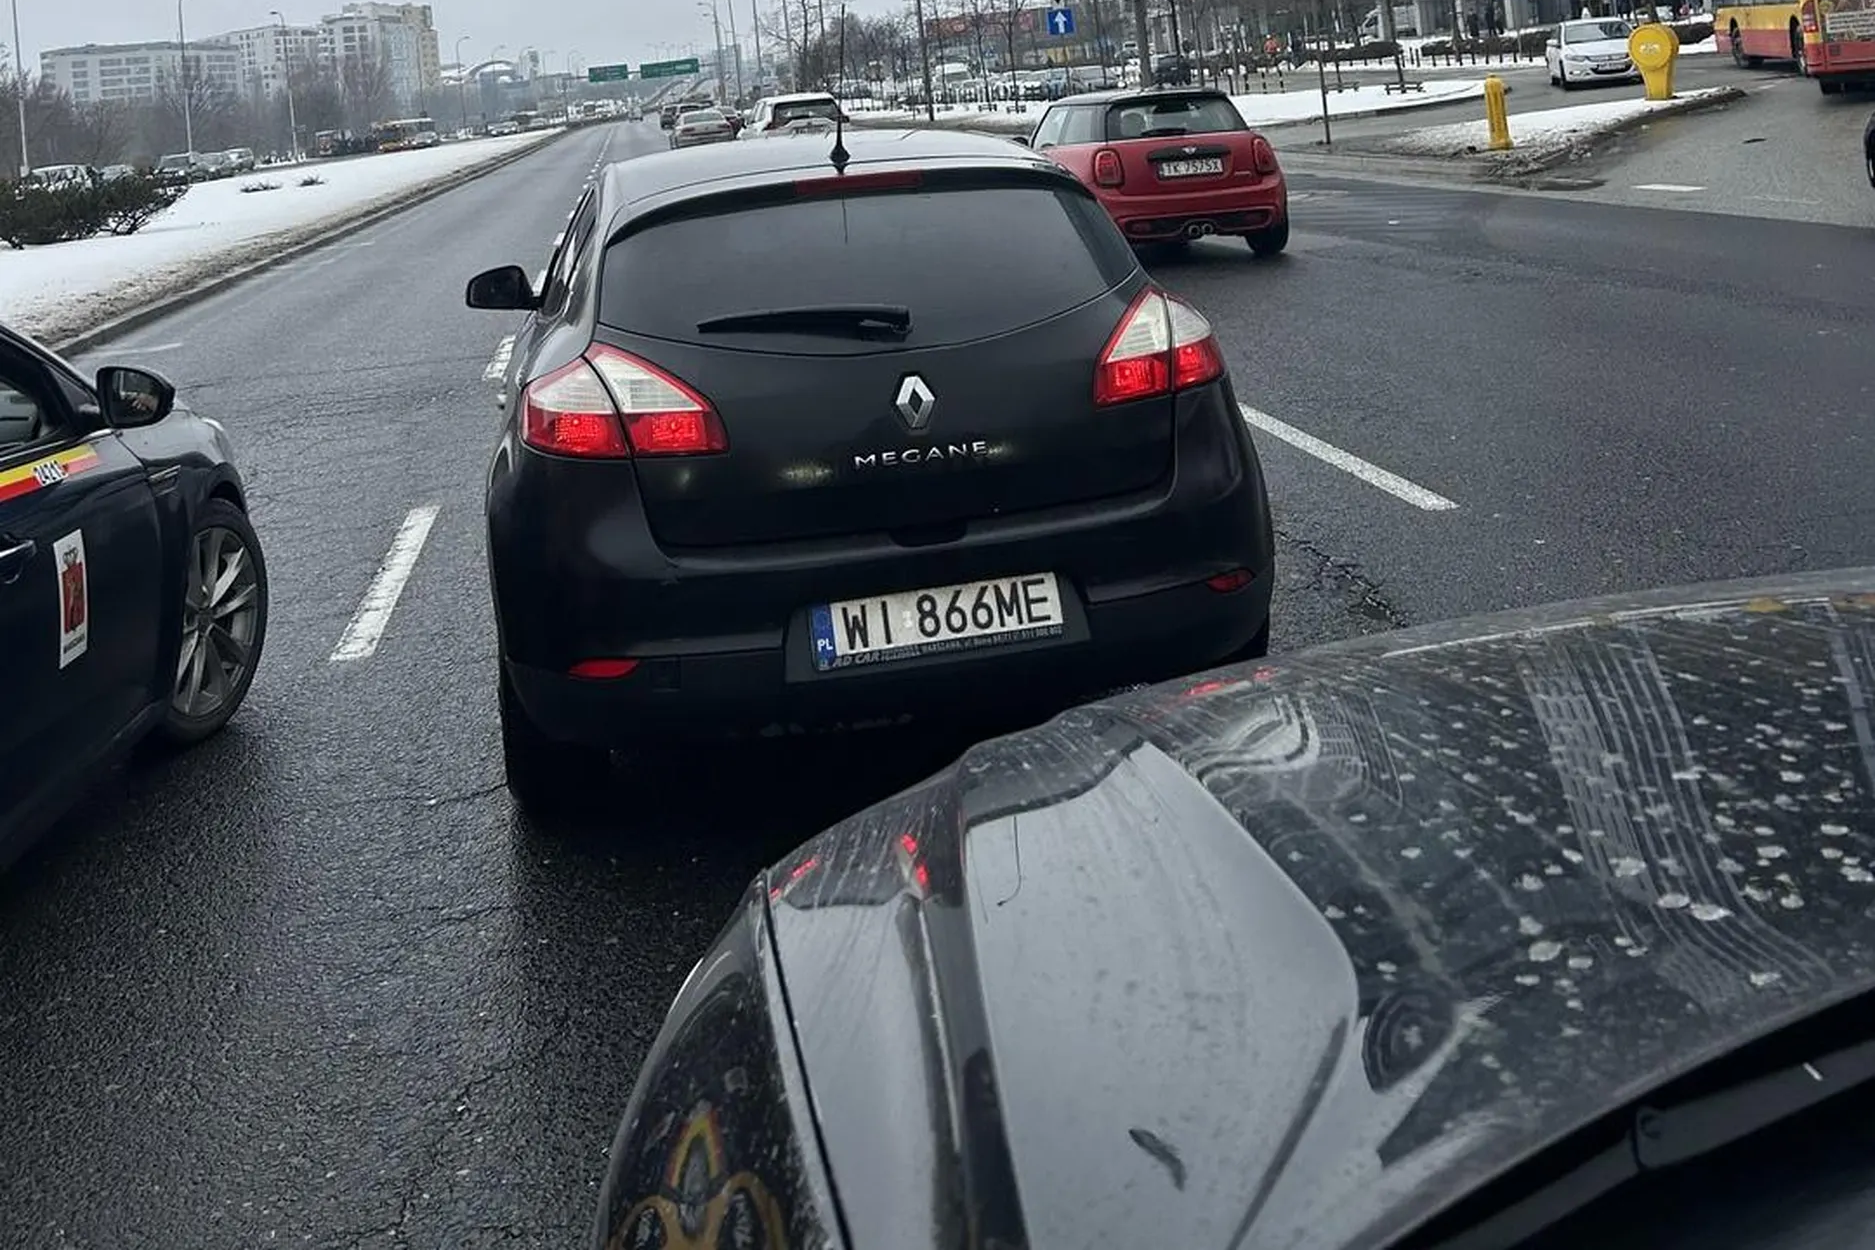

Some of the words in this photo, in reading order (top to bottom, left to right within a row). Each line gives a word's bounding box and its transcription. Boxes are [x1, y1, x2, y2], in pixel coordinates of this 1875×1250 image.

[854, 440, 987, 470] MEGANE
[841, 601, 892, 650] WI
[916, 578, 1052, 638] 866ME
[816, 638, 834, 653] PL
